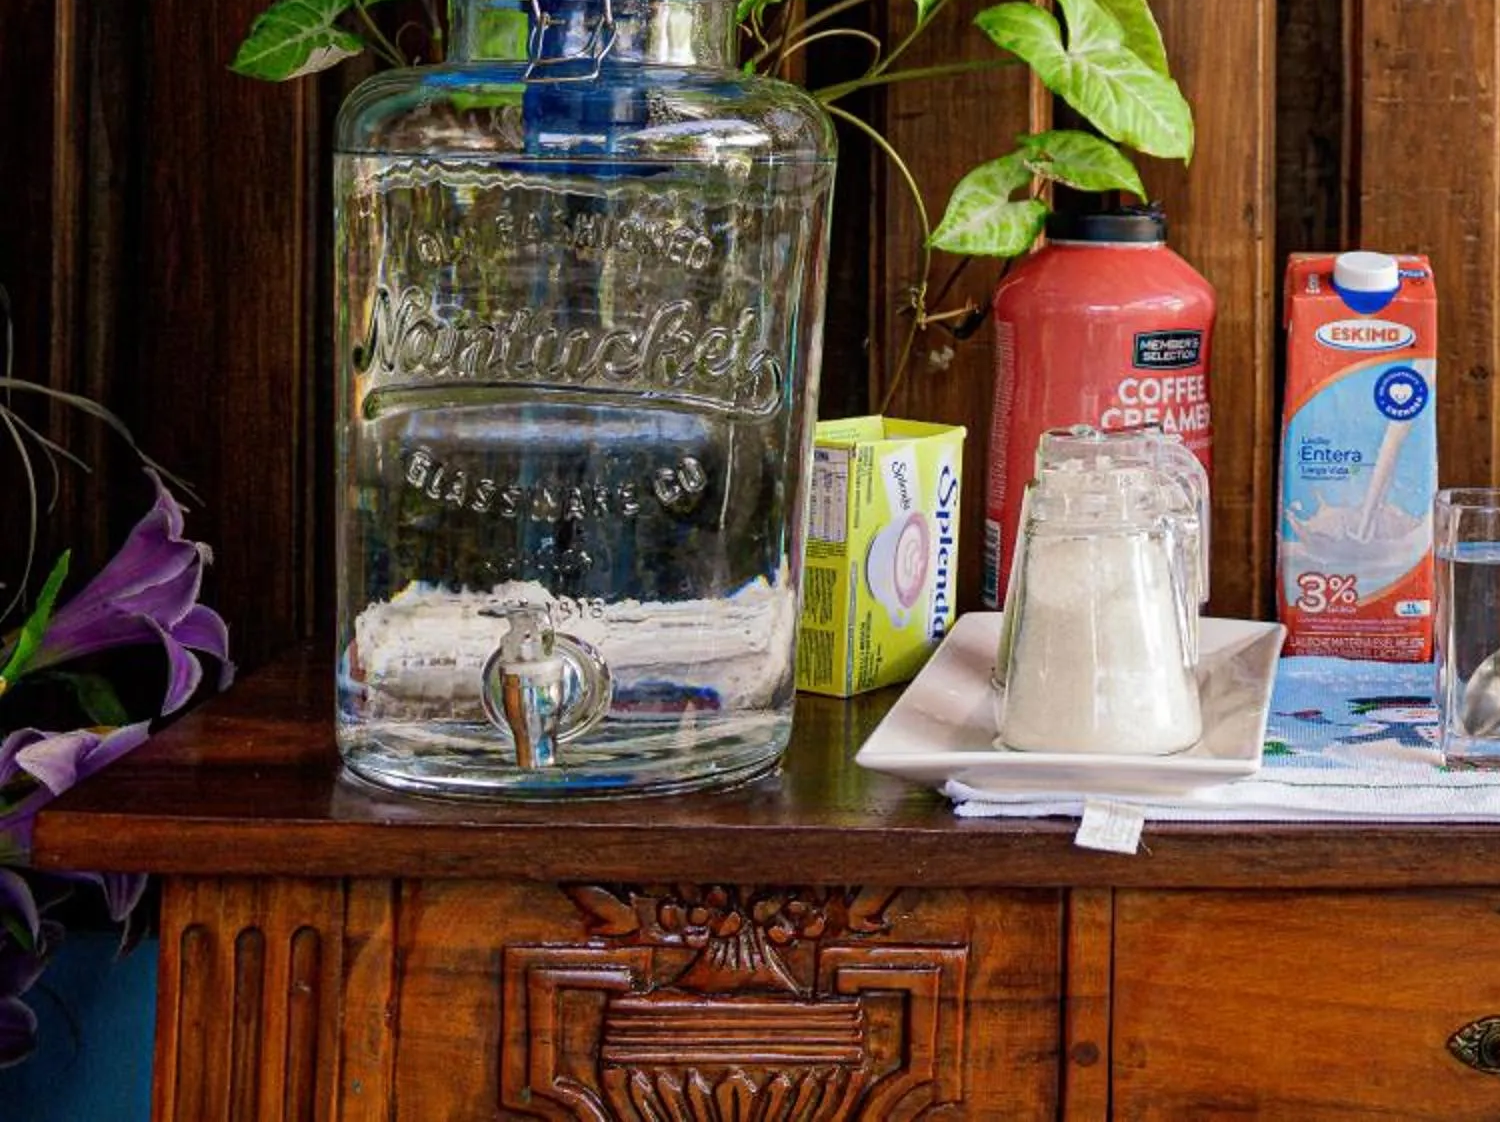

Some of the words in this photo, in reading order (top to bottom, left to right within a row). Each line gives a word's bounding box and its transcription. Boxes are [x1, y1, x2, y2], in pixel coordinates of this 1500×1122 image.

[1331, 327, 1400, 342] ESKIMO
[1142, 349, 1197, 362] SELECTION
[1117, 374, 1206, 406] COFFEE
[1300, 445, 1363, 464] Entera
[932, 464, 960, 639] Splenda
[1297, 571, 1358, 614] 3%
